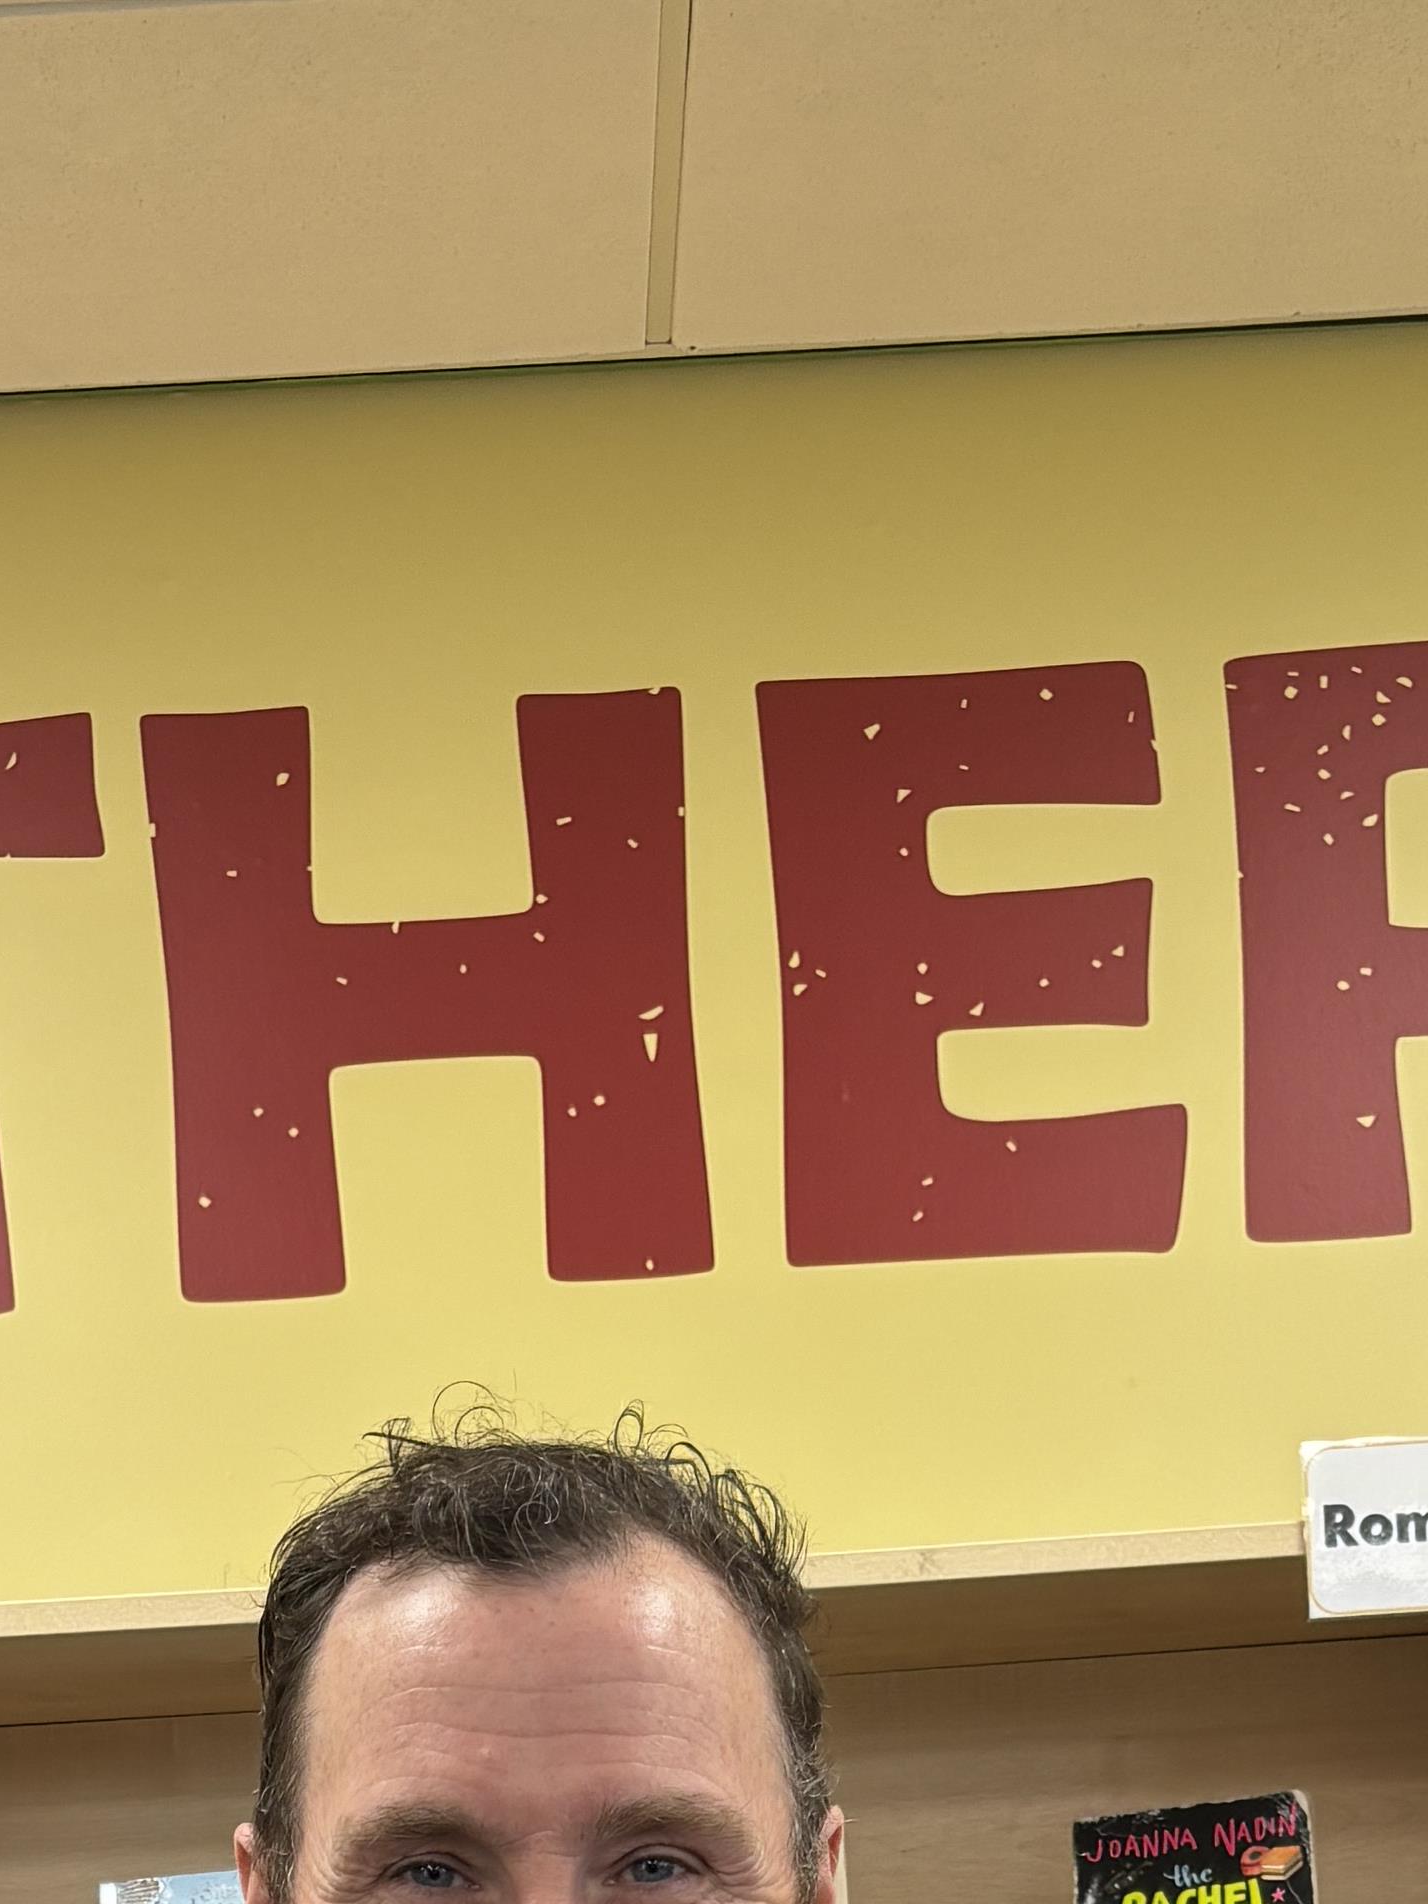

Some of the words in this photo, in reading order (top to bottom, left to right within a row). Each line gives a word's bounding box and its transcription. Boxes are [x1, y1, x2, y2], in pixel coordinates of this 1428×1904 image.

[1083, 1828, 1197, 1864] JOANNA
[1214, 1802, 1297, 1857] NADIN
[1165, 1864, 1213, 1887] the
